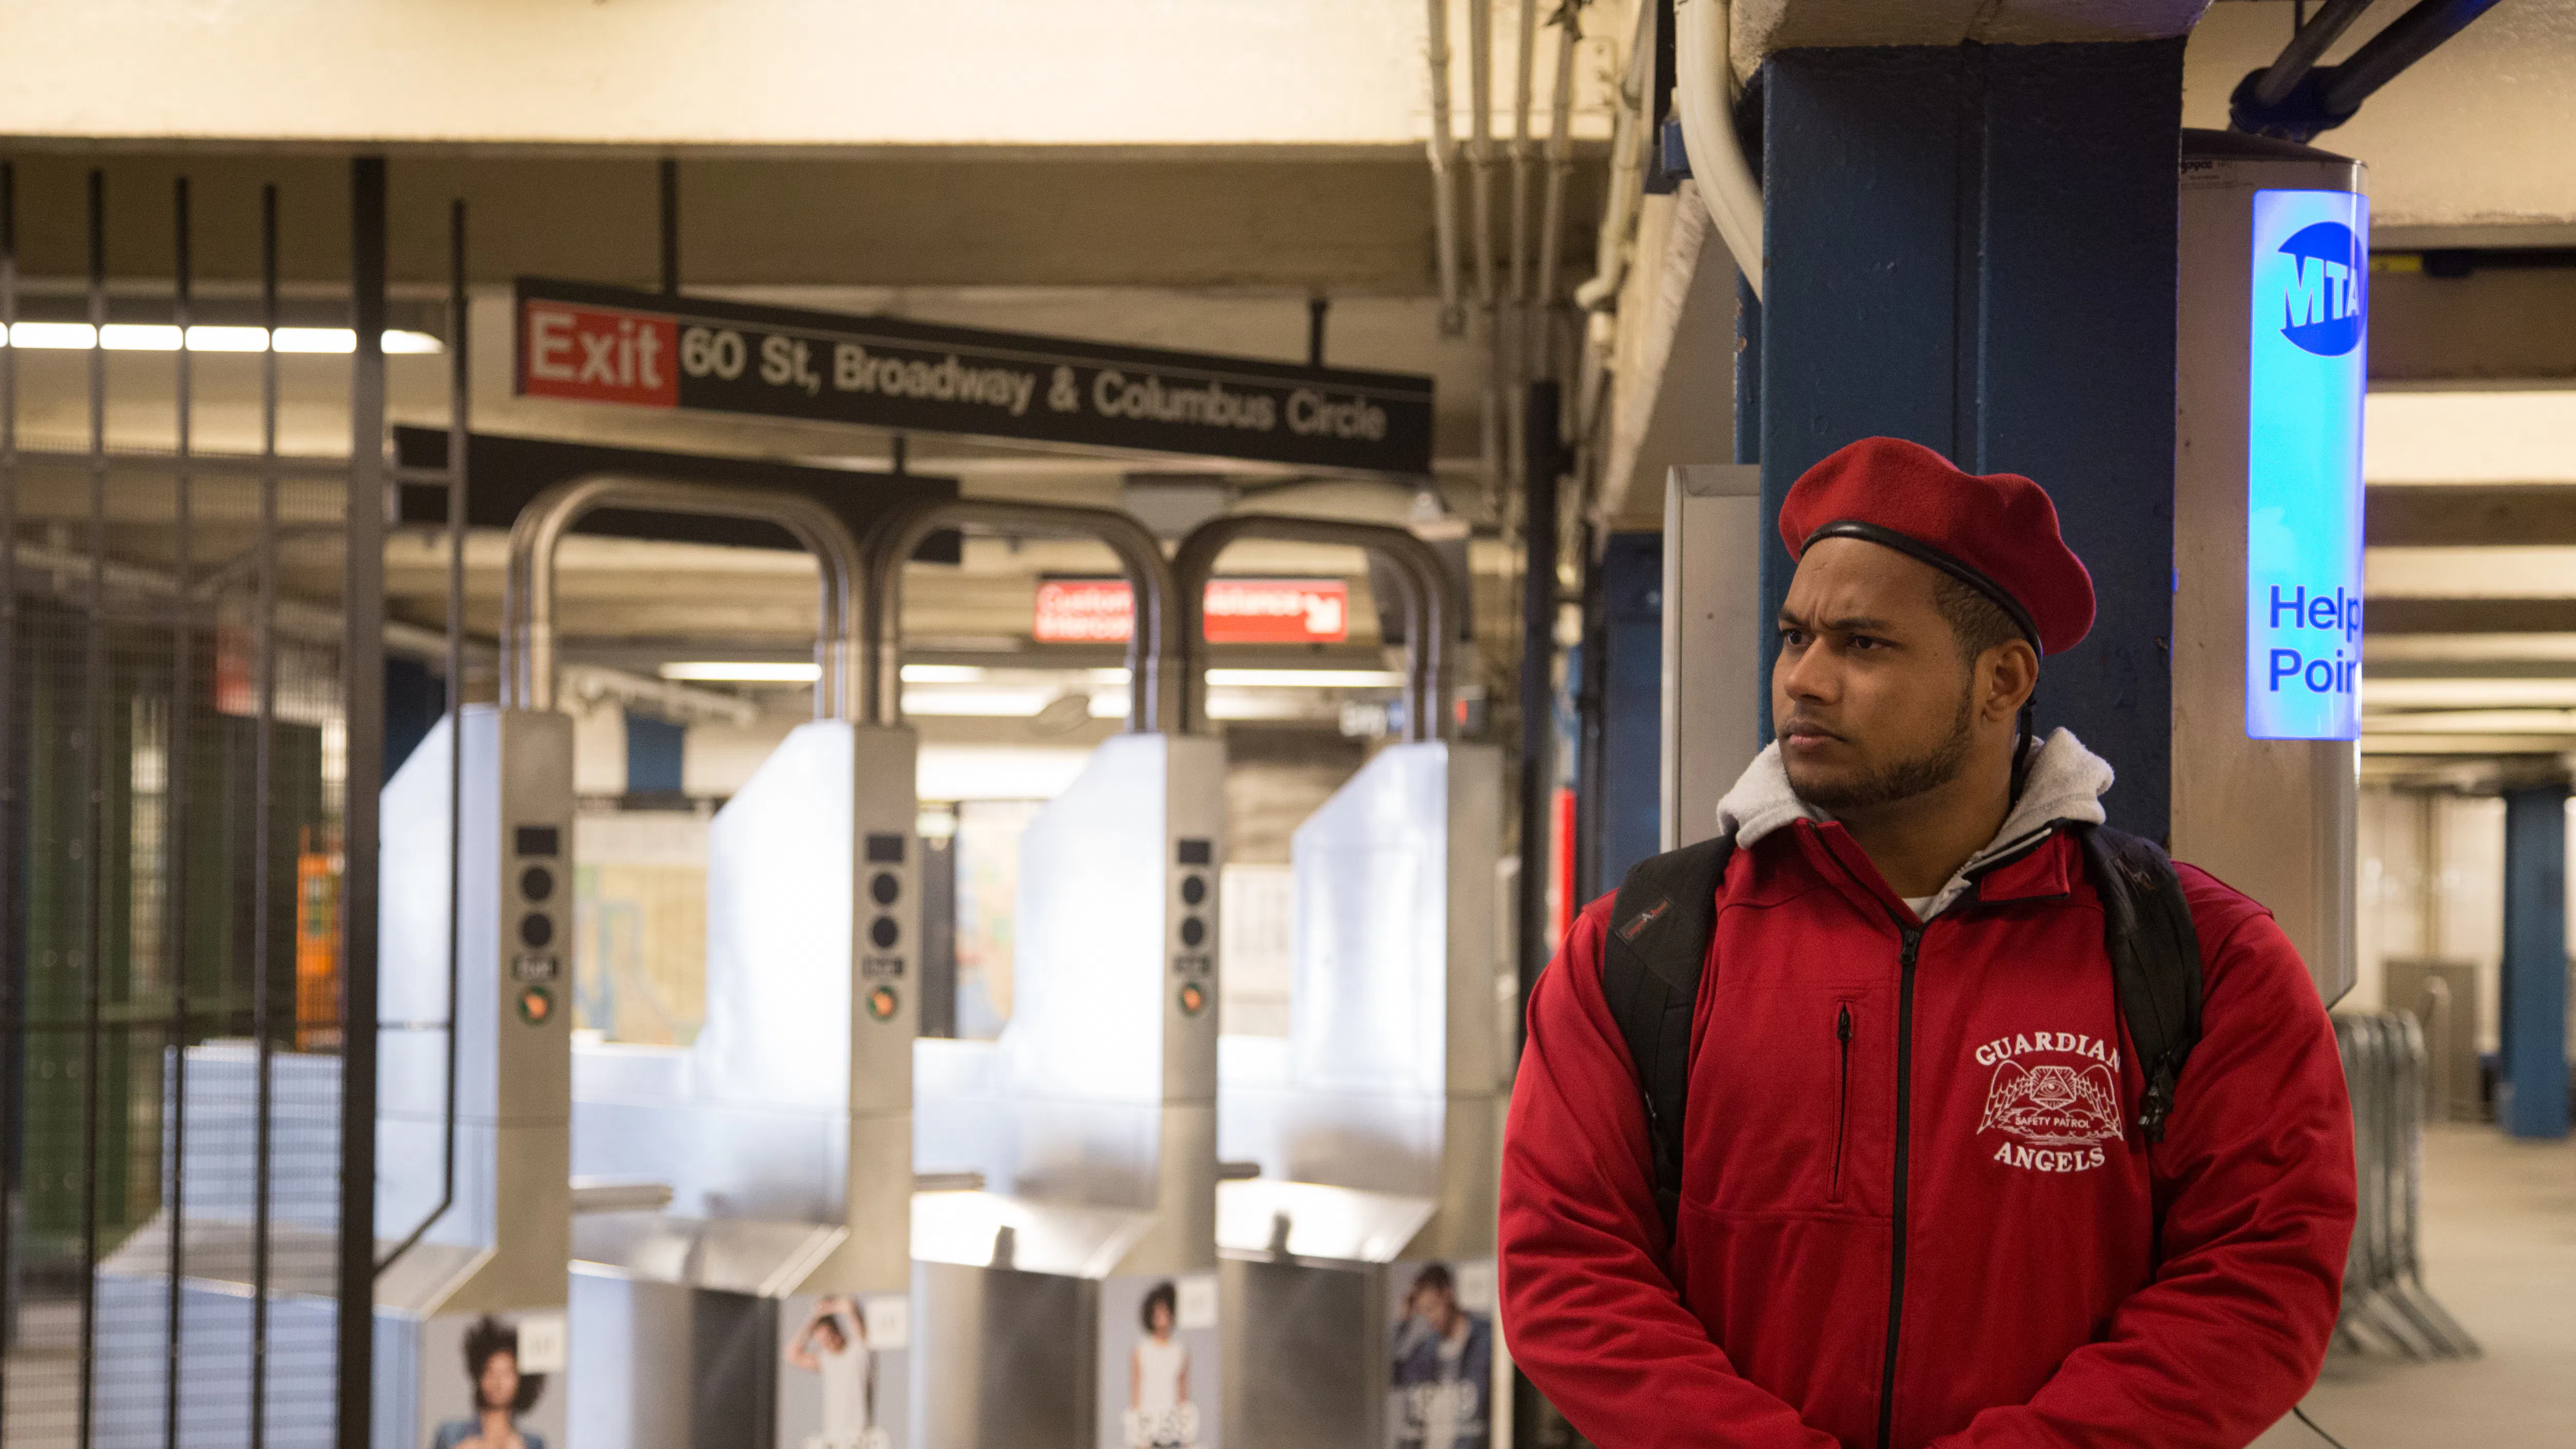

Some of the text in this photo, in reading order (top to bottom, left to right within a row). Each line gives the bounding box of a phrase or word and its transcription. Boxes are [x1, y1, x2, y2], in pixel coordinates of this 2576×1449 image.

[2285, 252, 2360, 328] MTA
[528, 312, 1387, 441] Exit 60 St, Broadway & Columbus Circle
[1037, 584, 1132, 613] Custom
[2269, 585, 2360, 643] Help
[1975, 1031, 2121, 1073] GUARDIAN
[2015, 1116, 2091, 1129] SAFETY PATROL
[1993, 1141, 2106, 1173] ANGELS
